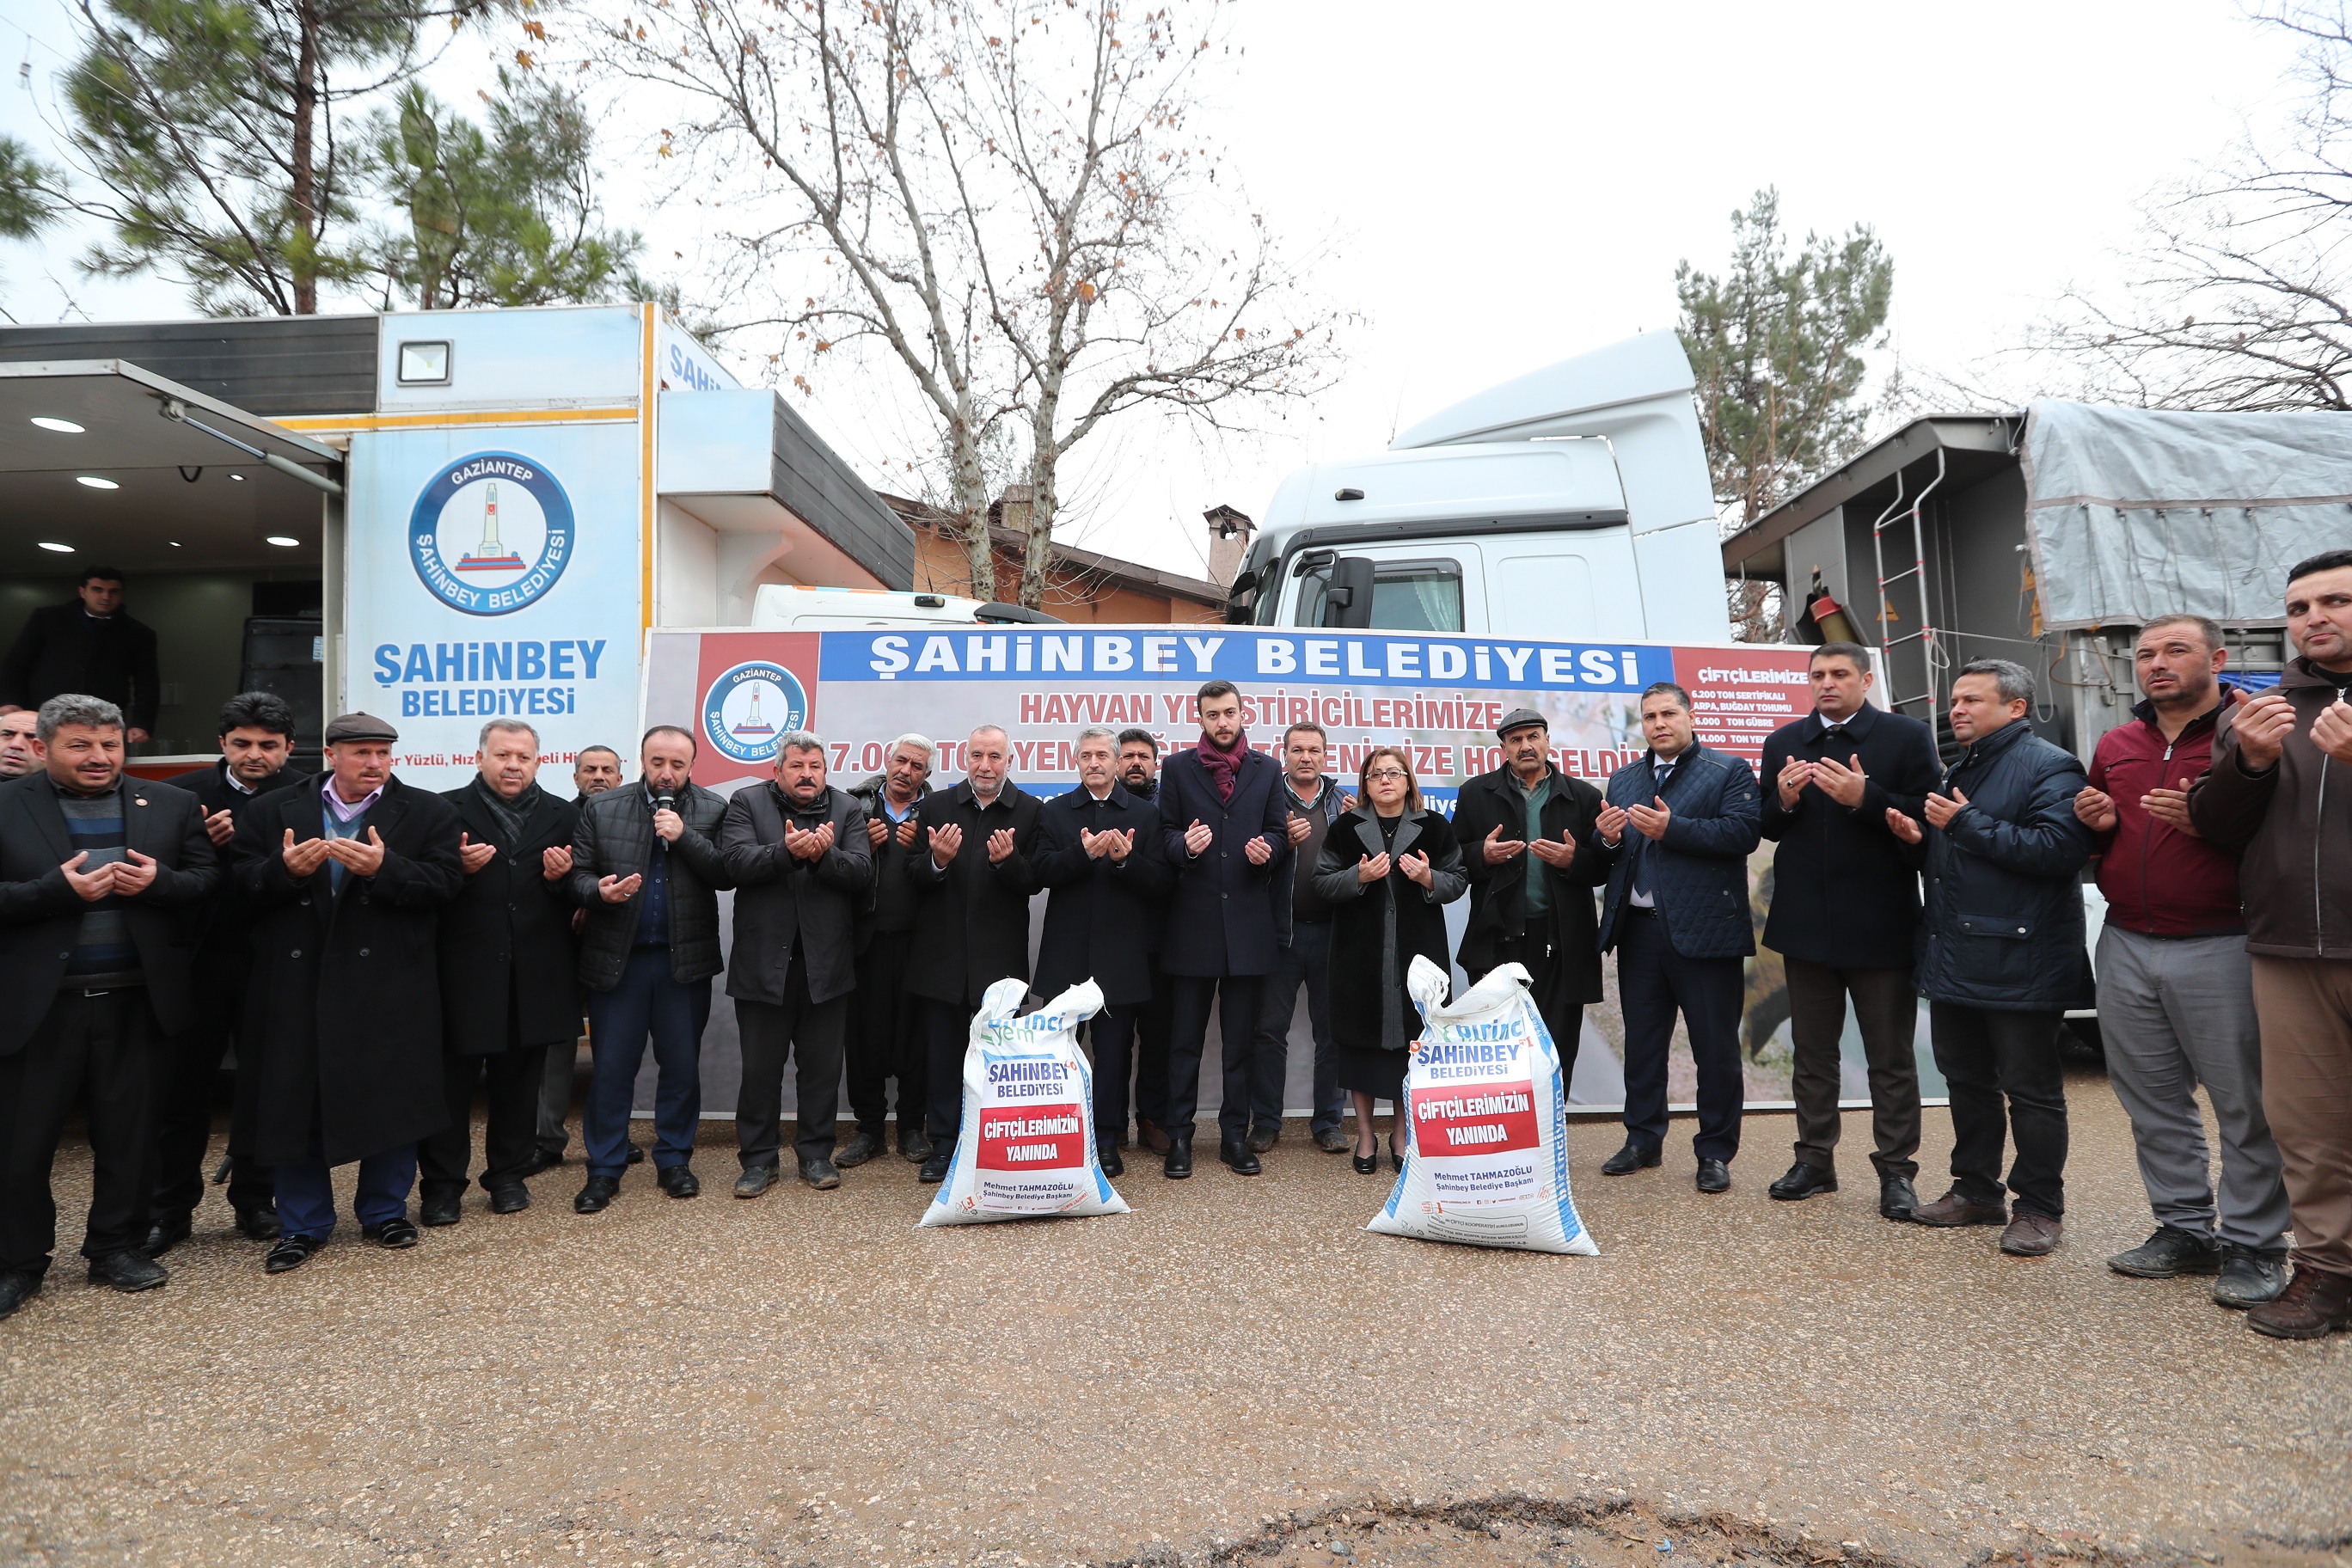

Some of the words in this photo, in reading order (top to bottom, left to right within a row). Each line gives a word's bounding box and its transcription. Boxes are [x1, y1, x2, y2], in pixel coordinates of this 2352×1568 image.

[450, 459, 533, 485] GAZİANTEP
[416, 533, 481, 607] ŞAHİNBEY
[488, 529, 566, 609] BELEDİYESİ
[732, 668, 781, 683] GAZİANTEP
[1697, 667, 1810, 684] ÇİFTÇİLERİMİZE
[1691, 689, 1716, 699] 6.200
[1717, 691, 1735, 700] TON
[1020, 693, 1153, 725] HAYVAN
[1694, 701, 1719, 712] ARPA,
[1720, 701, 1755, 712] BUĞDAY
[1756, 703, 1792, 713] TOHUMU
[1695, 717, 1721, 726] 6.000
[1726, 718, 1745, 726] TON
[1746, 717, 1774, 727] GÜBRE
[1730, 735, 1749, 744] TON
[404, 754, 448, 767] Yüzlü,
[992, 1026, 1034, 1046] yem
[1418, 1090, 1529, 1123] ÇİFTÇİLERİMİZİN
[984, 1114, 1079, 1142] ÇİFTÇİLERİMİZİN
[1446, 1124, 1509, 1146] YANINDA
[1006, 1143, 1058, 1161] YANINDA
[1434, 1173, 1468, 1181] Mehmet
[1470, 1165, 1533, 1180] TAHMAZOĞLU
[983, 1181, 1016, 1191] Mehmet
[1018, 1181, 1074, 1191] TAHMAZOĞLU
[1436, 1183, 1468, 1192] Şahinbey
[1470, 1182, 1504, 1191] Belediye
[1504, 1178, 1534, 1188] Başkanı
[983, 1190, 1014, 1200] Şahinbey
[1015, 1191, 1044, 1200] Belediye
[1045, 1191, 1073, 1200] Başkanı
